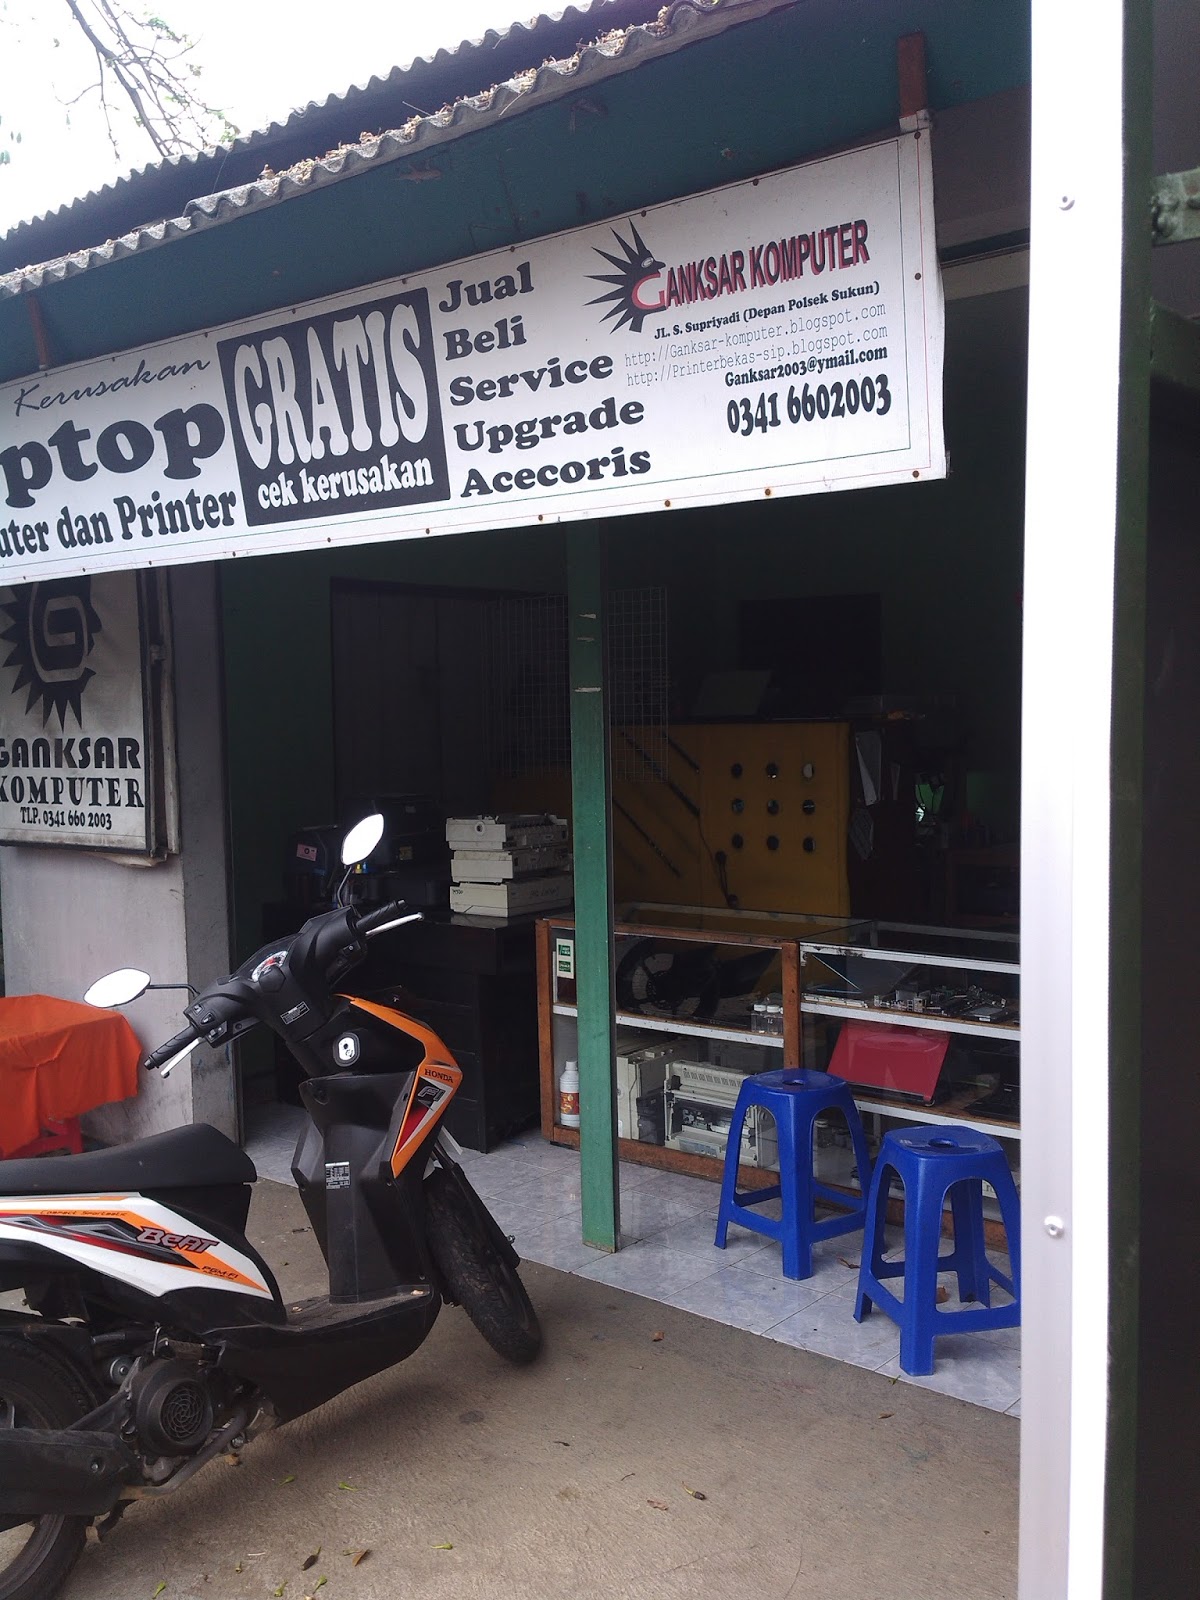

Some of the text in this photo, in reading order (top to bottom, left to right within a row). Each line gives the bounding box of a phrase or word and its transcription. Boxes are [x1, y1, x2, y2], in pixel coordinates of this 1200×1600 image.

[438, 261, 534, 313] Jual
[631, 219, 871, 309] GANKSAR KOMPUTER
[443, 315, 527, 361] Beli
[624, 303, 887, 367] http://Ganksar-komputer.blogspot.com
[654, 280, 880, 340] JL. S. Supriyadi (Depan Polsek Sukun)
[449, 355, 614, 406] Service
[626, 326, 888, 387] http://Printerbekas-sip.blogspot.com
[724, 346, 888, 387] Ganksar2003@ymail.com
[13, 355, 211, 417] Kerusakan
[233, 303, 429, 470] GRATIS
[727, 373, 892, 436] 0341 6602003
[453, 397, 645, 454] Upgrade
[0, 403, 226, 509] ptop
[258, 454, 435, 510] cek kerusakan
[460, 446, 651, 498] Acecoris
[56, 506, 114, 549] dan
[113, 488, 237, 540] Printer
[0, 737, 141, 769] GANKSAR
[0, 775, 144, 807] KOMPUTER
[20, 806, 113, 831] TLP. 0341 660 2003
[424, 1068, 454, 1083] HONDA
